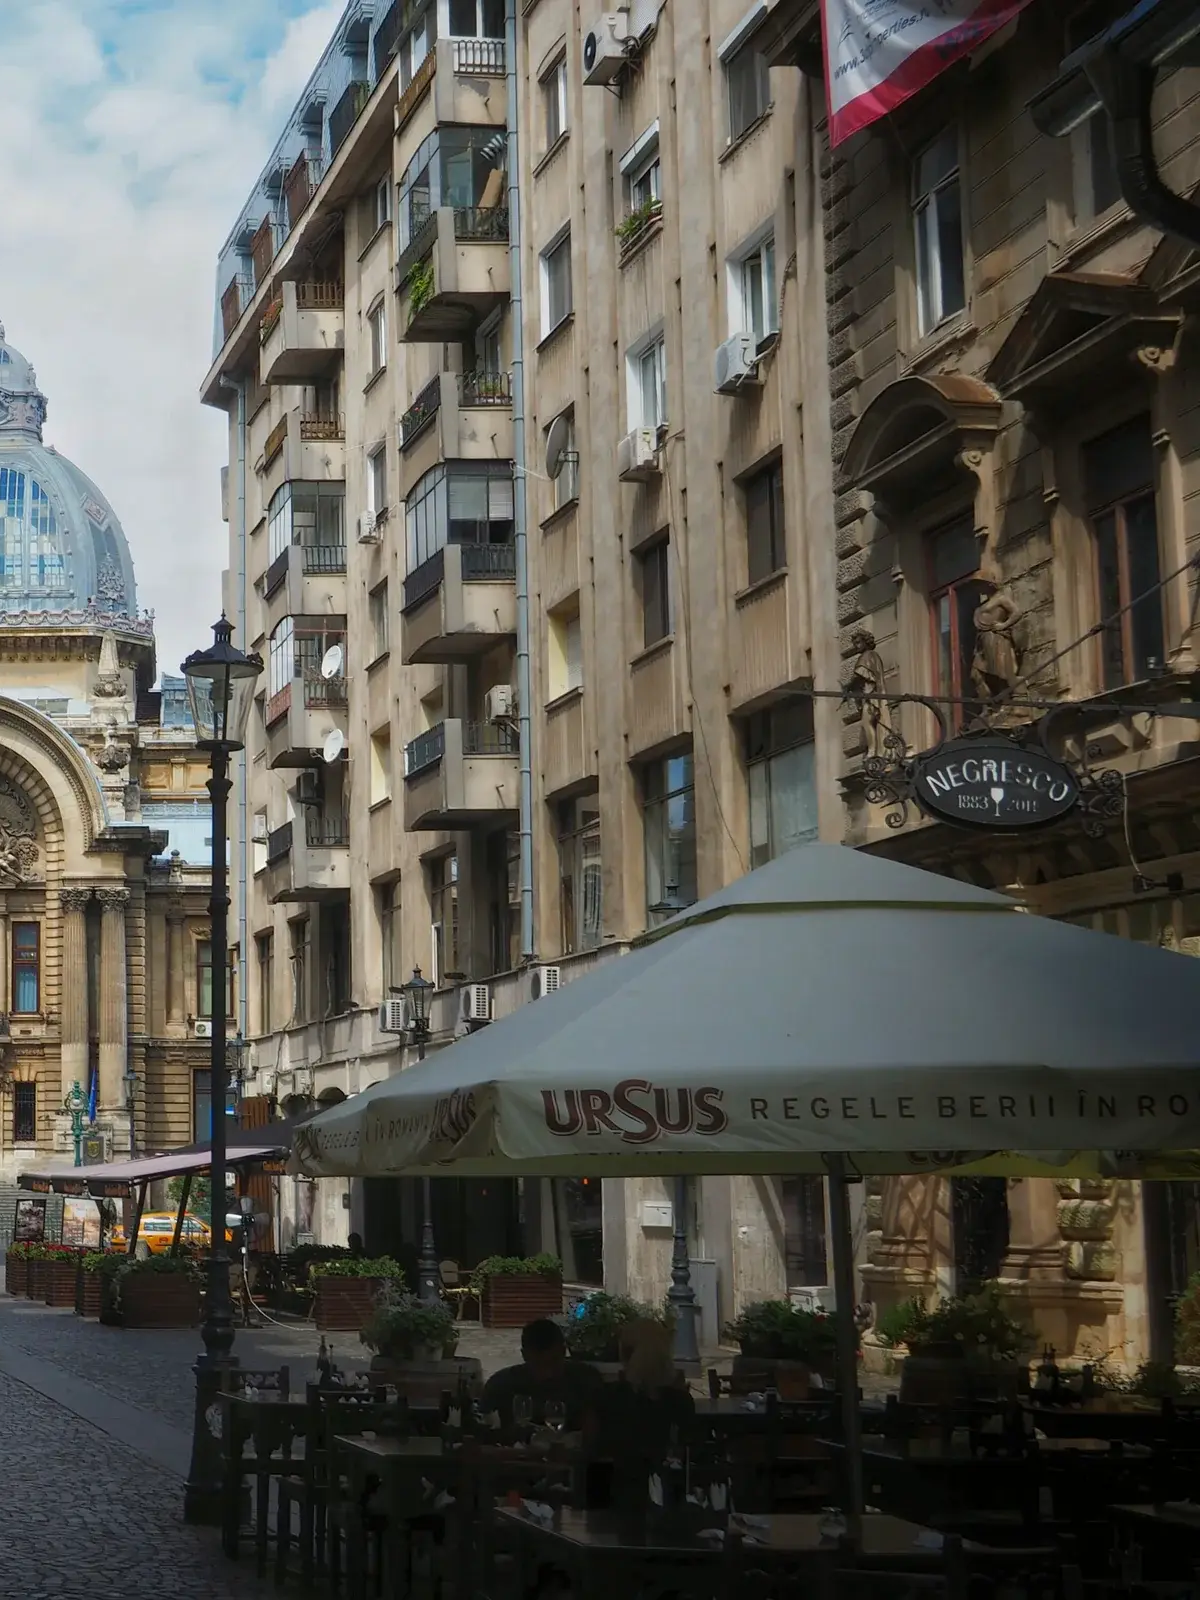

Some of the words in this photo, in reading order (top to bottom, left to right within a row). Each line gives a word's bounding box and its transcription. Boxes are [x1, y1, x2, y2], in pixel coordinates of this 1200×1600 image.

[925, 759, 1069, 802] NEGRESCO
[958, 794, 989, 809] 1883
[428, 1088, 477, 1145] URSUS
[540, 1079, 729, 1144] URSUS
[750, 1097, 915, 1119] REGELE
[937, 1094, 1054, 1118] BERII
[1078, 1089, 1117, 1118] ÎN
